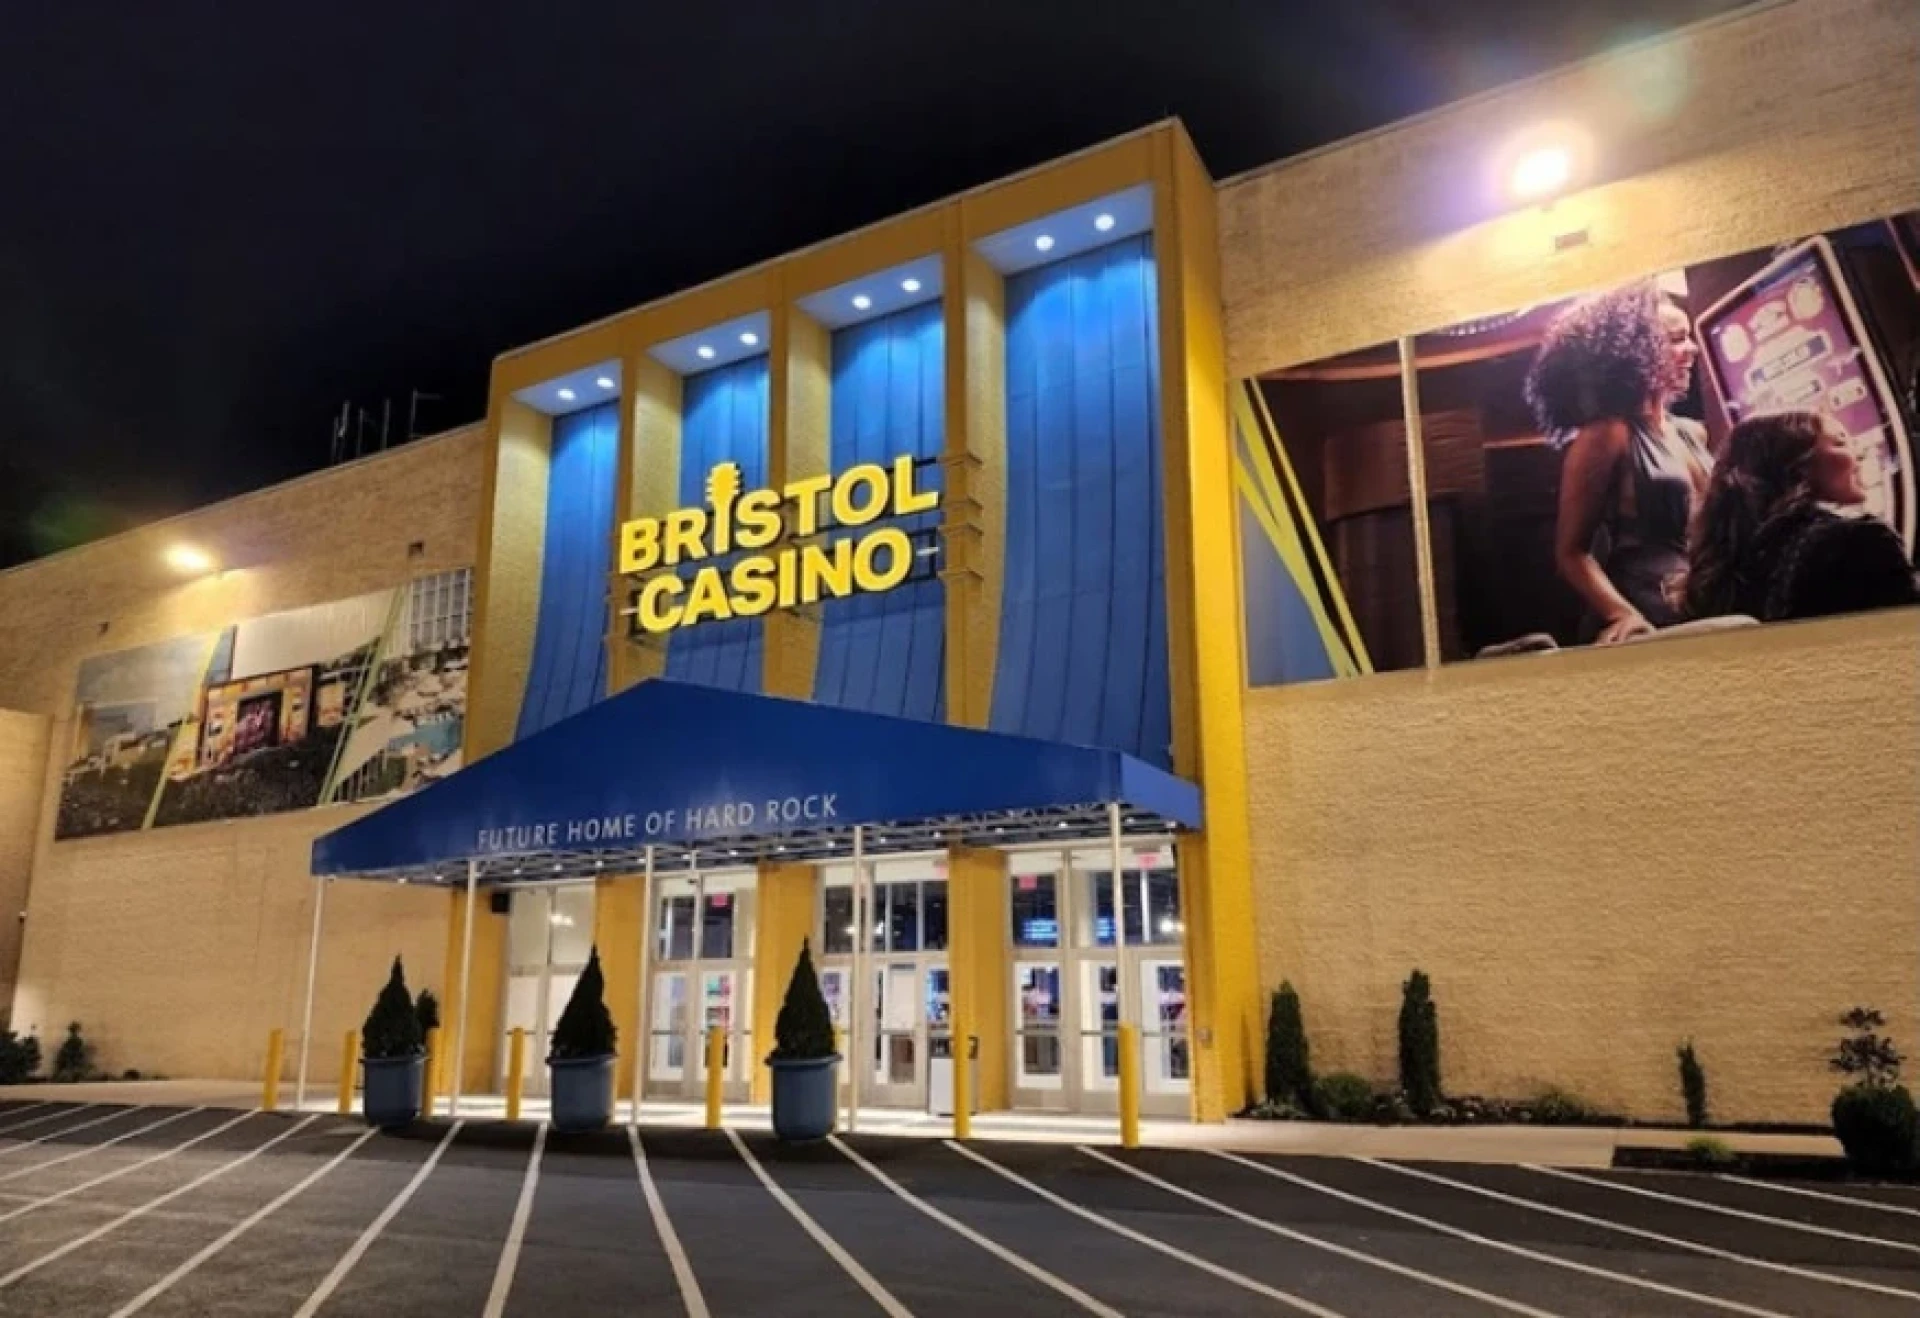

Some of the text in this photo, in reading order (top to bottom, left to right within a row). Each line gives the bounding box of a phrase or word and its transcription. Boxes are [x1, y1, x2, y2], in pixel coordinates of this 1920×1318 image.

[619, 455, 939, 574] BRISTOL
[638, 527, 913, 633] CASINO
[477, 794, 839, 851] FUTURE HOME OF HARD ROCK
